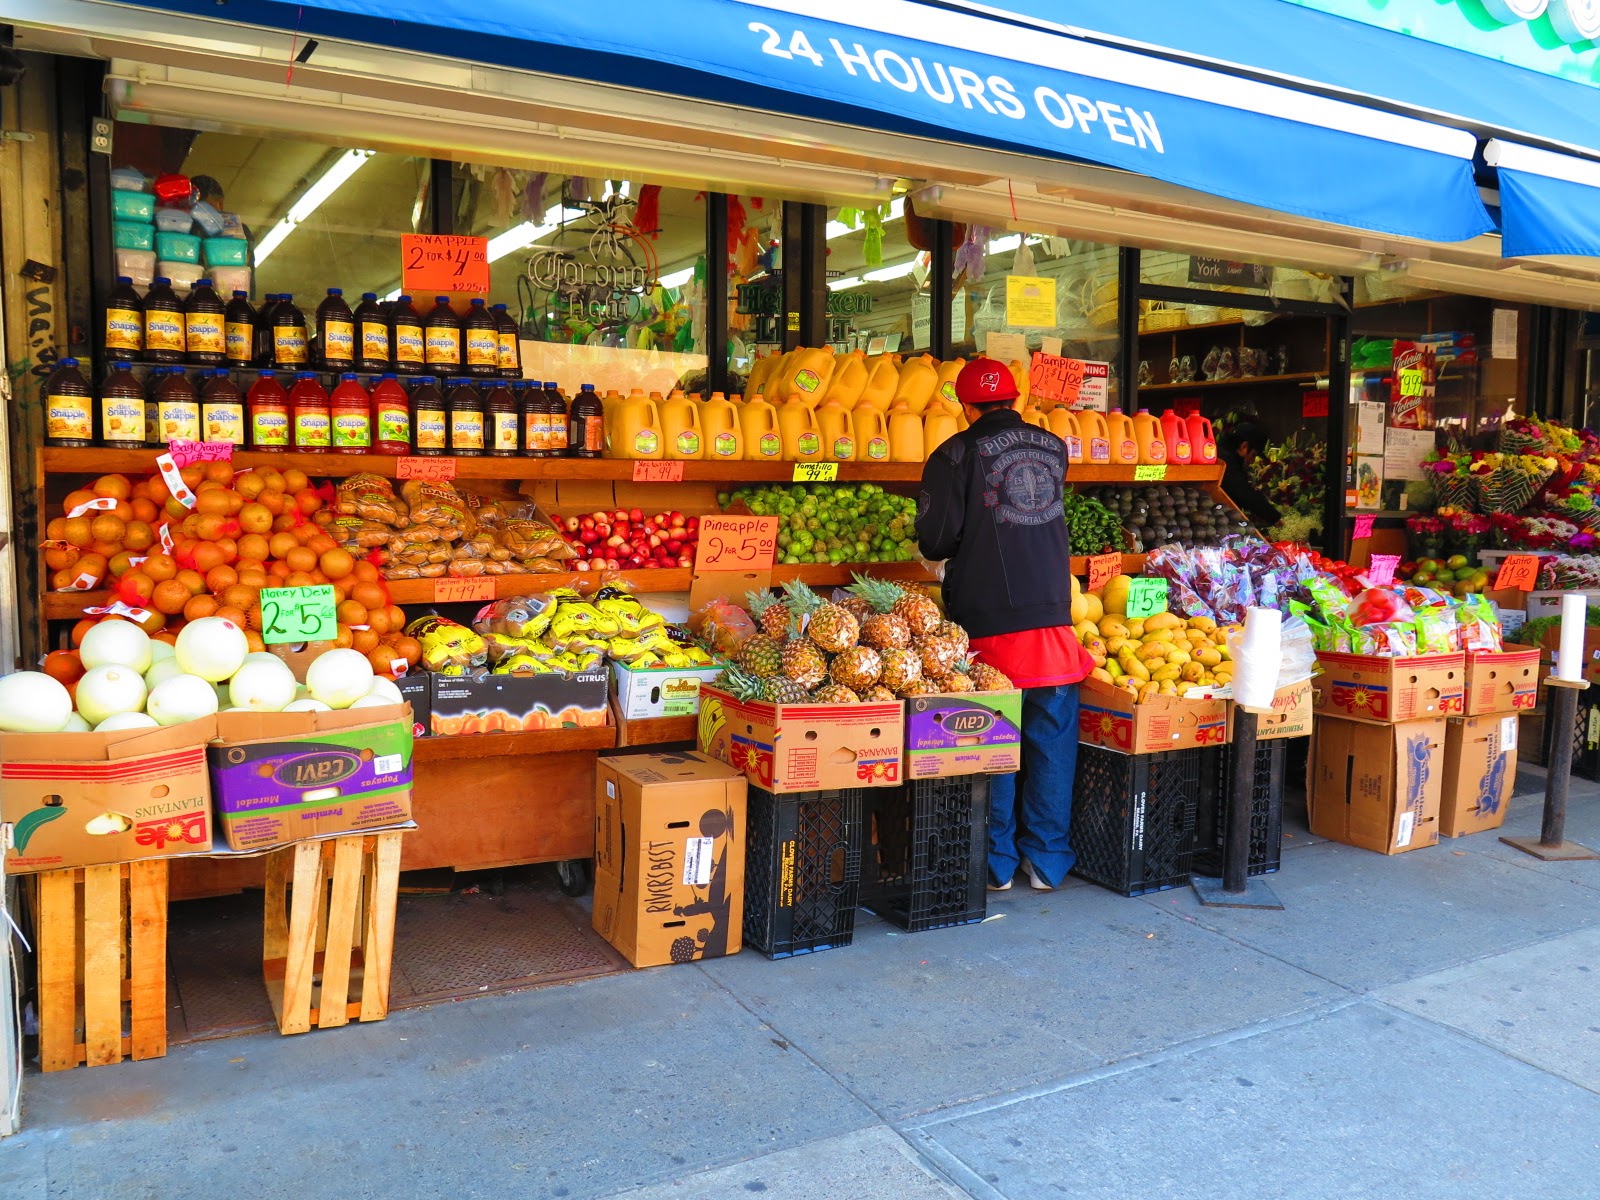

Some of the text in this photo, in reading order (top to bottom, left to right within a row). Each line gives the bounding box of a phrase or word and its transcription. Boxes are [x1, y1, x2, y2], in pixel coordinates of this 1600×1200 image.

[747, 21, 1165, 155] 24 HOURS OPEN
[414, 234, 480, 247] SNAPPLE
[407, 246, 425, 270] 2
[528, 250, 651, 293] Corona
[1197, 261, 1220, 277] York
[148, 321, 180, 334] Snapple
[188, 324, 219, 335] Snapple
[427, 337, 455, 348] Snapple
[1039, 353, 1080, 371] Tampico
[1031, 364, 1045, 390] 2
[50, 408, 86, 421] Snapple
[107, 406, 141, 420] Snapple
[163, 411, 196, 424] Snapple
[207, 413, 239, 425] Snapple
[257, 416, 287, 427] Snapple
[300, 418, 329, 429] Snapple
[337, 418, 366, 429] Snapple
[454, 422, 481, 432] Snapple
[983, 431, 1059, 455] PIONEERS
[993, 451, 1059, 473] LEAD NOT FOLLOW
[400, 464, 412, 478] 2
[420, 488, 462, 503] IDAHO
[1002, 504, 1063, 524] IMMORTAL LIONS
[703, 519, 769, 536] Pineapple
[705, 536, 724, 564] 2
[1093, 555, 1118, 566] melon
[1091, 568, 1100, 584] 2
[260, 586, 332, 600] Honey Dew
[262, 601, 287, 635] 2
[576, 674, 606, 683] CITRUS
[1331, 685, 1388, 719] Dole
[1439, 697, 1463, 714] Dole
[1511, 693, 1536, 709] Dole
[1079, 710, 1133, 750] Dole
[1194, 725, 1226, 745] Dole
[1276, 723, 1304, 734] PREMIUM
[858, 746, 899, 758] BANANAS
[954, 754, 982, 763] Premium
[730, 743, 773, 789] Dole
[1481, 733, 1493, 796] Sunsational
[360, 774, 399, 788] Papayas
[856, 761, 899, 785] Dole
[235, 794, 280, 808] Maradol
[1417, 760, 1428, 827] Sunsational
[134, 796, 204, 819] PLANTAINS
[300, 808, 344, 821] Premium
[135, 817, 208, 850] Dole
[788, 840, 796, 866] CLOVER
[644, 839, 676, 914] RIVER'S BEST
[787, 866, 795, 888] FARMS
